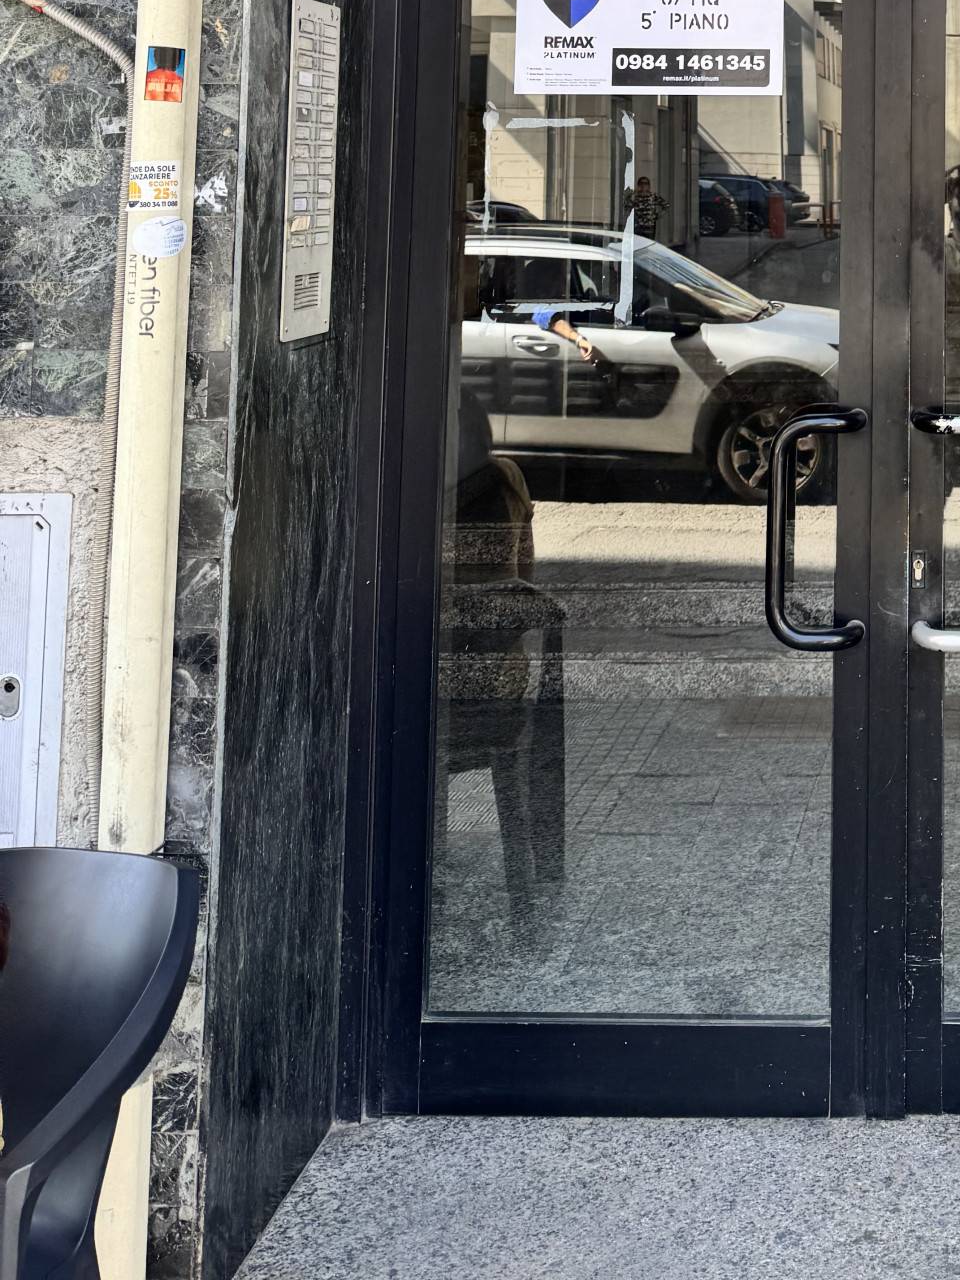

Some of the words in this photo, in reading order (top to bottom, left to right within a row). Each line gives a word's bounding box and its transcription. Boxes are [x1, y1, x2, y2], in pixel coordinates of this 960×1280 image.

[670, 12, 729, 30] PIANO
[544, 35, 594, 49] REMAX
[544, 51, 595, 59] PLATINUM
[615, 54, 668, 70] 0984
[675, 54, 766, 71] 1461345
[662, 75, 720, 83] remax.it/platinum
[153, 187, 178, 200] 25%
[128, 254, 138, 287] NTET
[139, 287, 161, 339] fiber
